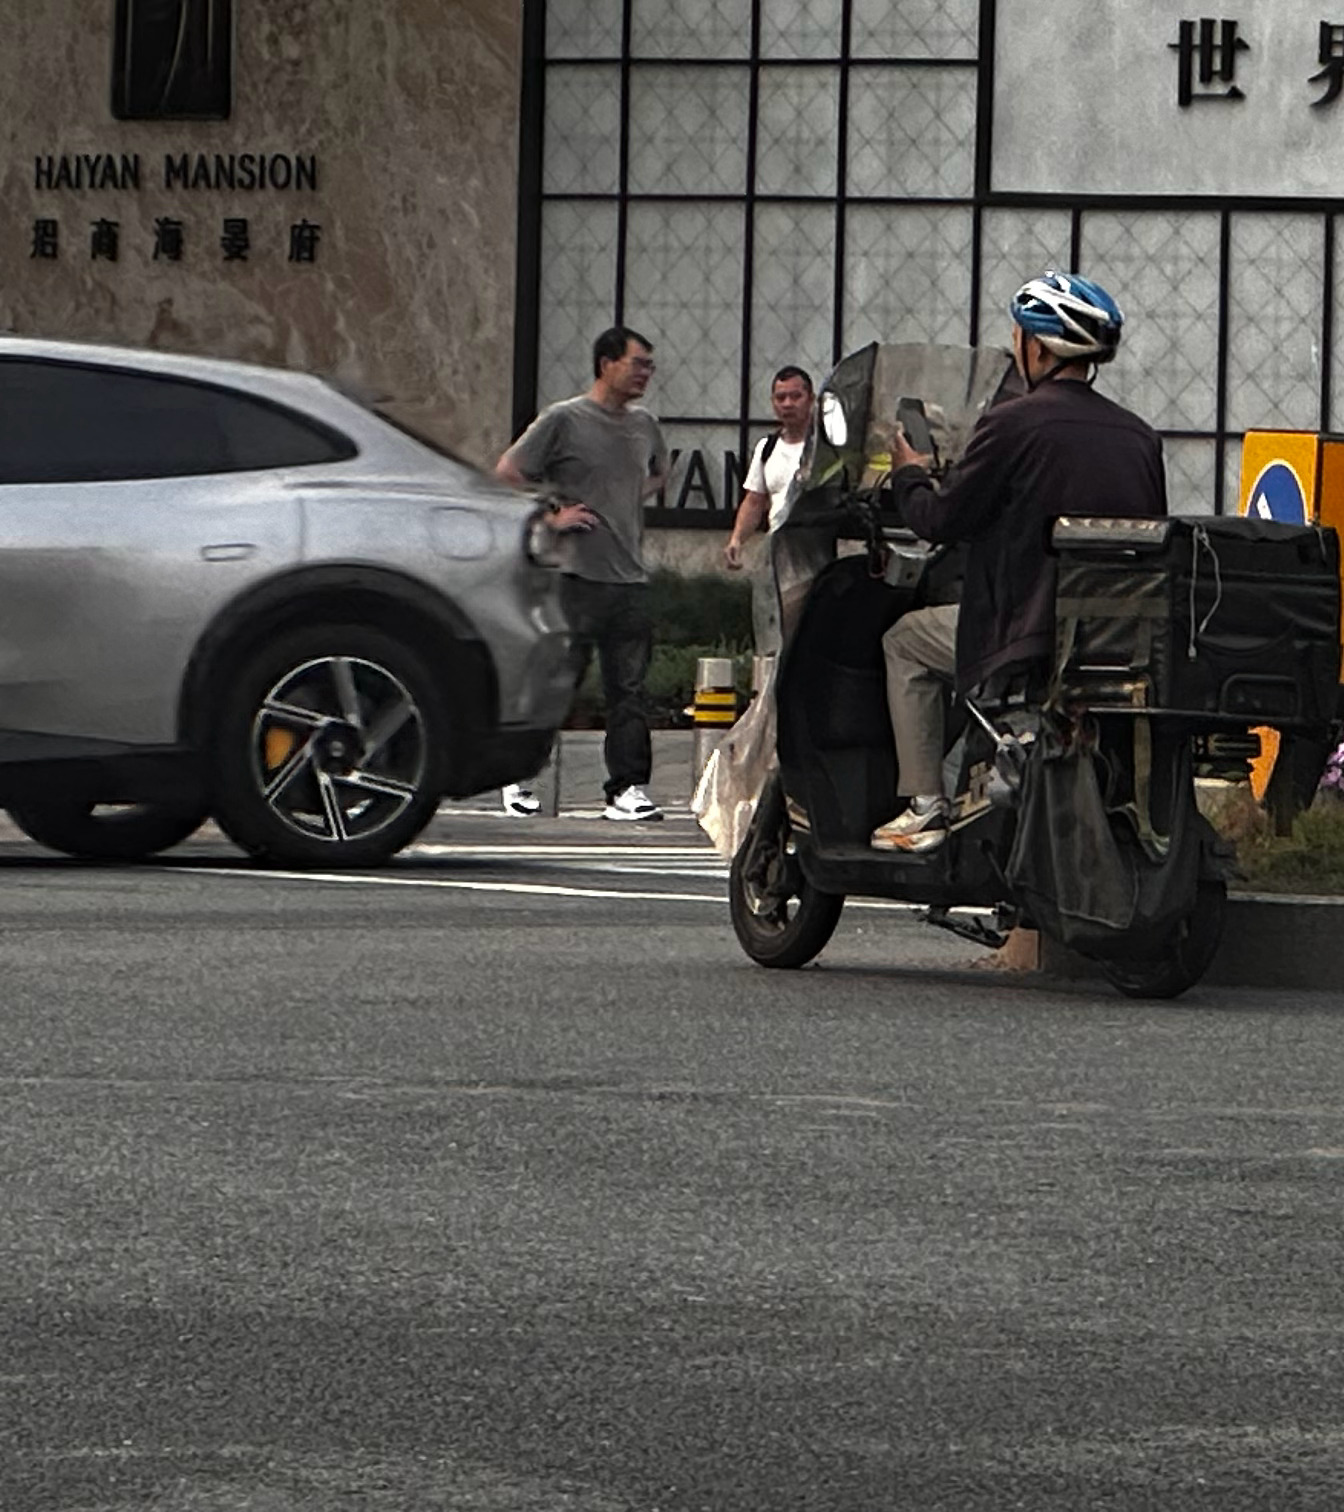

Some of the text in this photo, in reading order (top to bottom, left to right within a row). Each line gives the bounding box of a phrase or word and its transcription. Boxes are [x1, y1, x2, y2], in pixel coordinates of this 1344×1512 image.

[34, 153, 318, 191] HAIYAN MANSION
[30, 216, 323, 263] 招商海晏府
